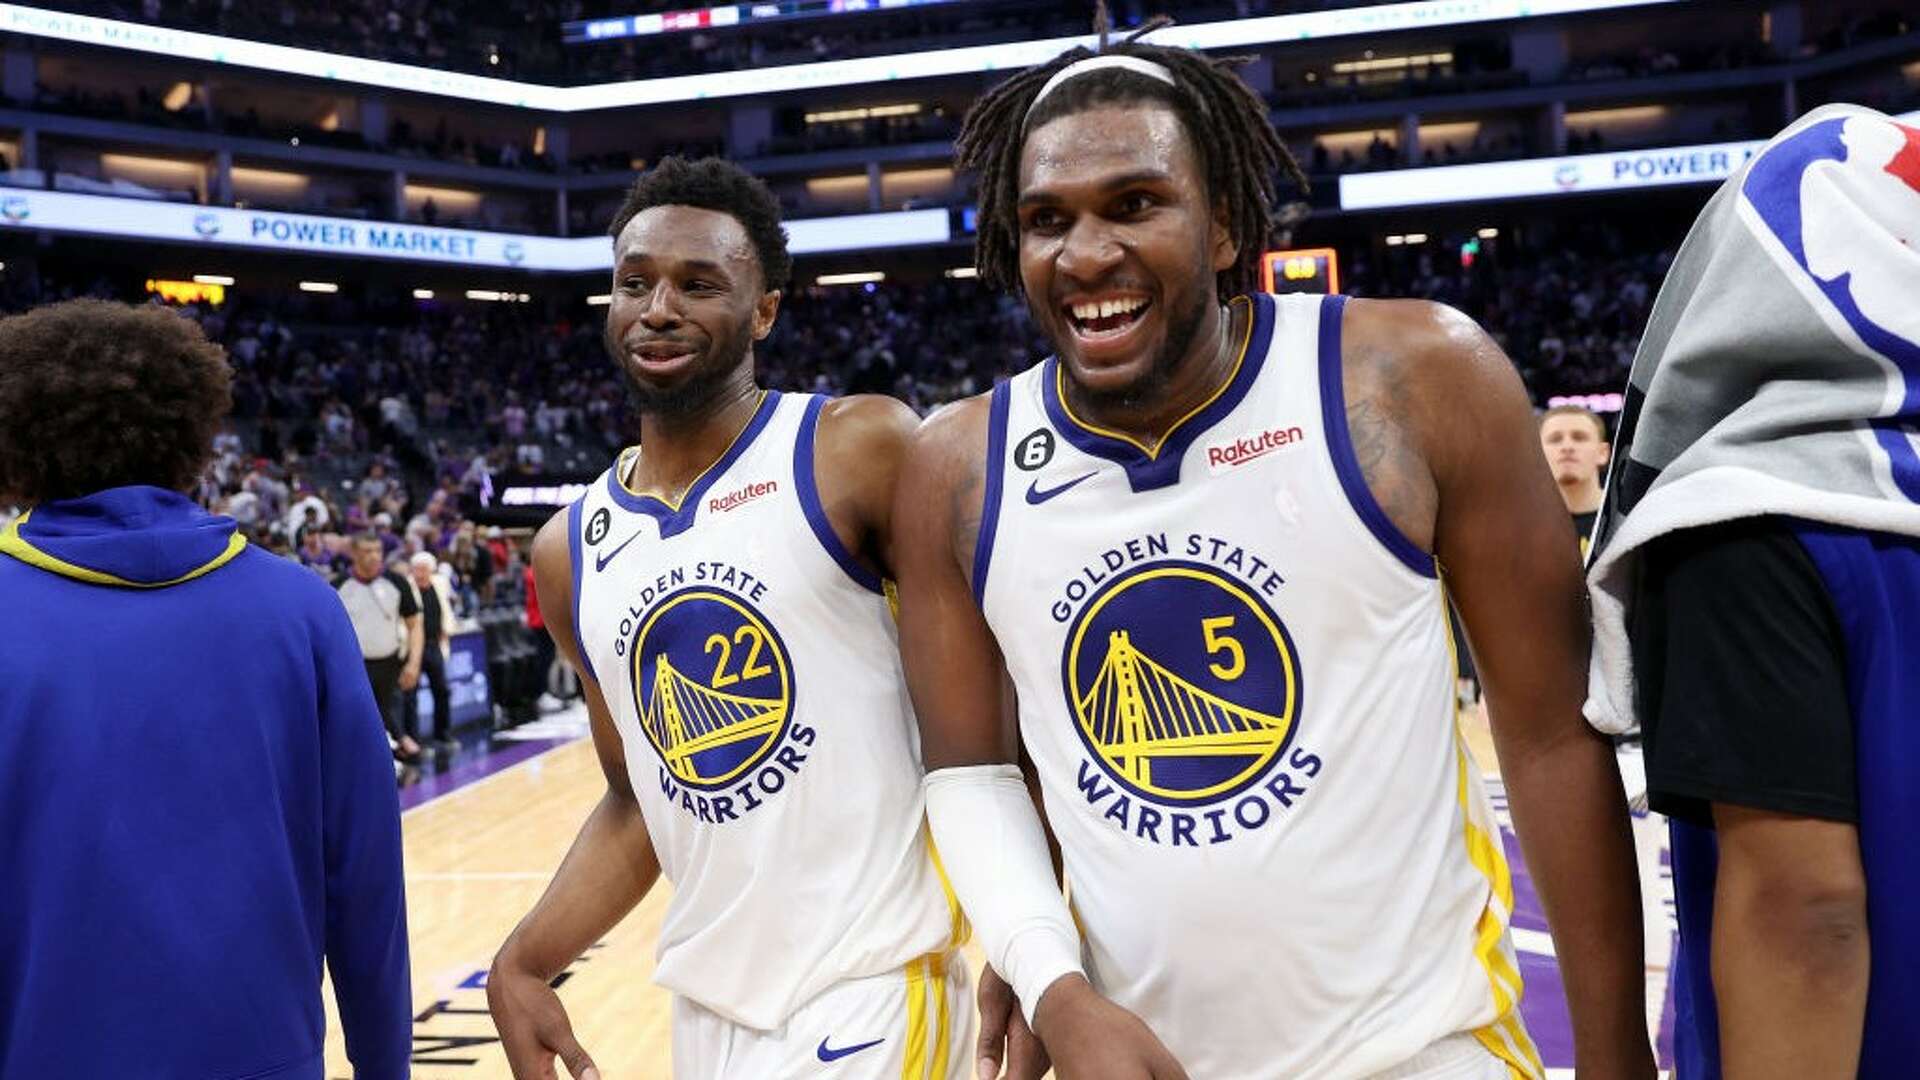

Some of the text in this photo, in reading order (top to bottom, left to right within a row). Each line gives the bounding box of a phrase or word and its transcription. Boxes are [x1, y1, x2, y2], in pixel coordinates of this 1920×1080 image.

[1613, 152, 1728, 180] POWER
[252, 218, 477, 257] POWER MARKET
[1021, 433, 1049, 468] 6
[1208, 426, 1303, 467] Rakuten
[709, 480, 777, 513] Rakuten
[589, 511, 608, 543] 6
[1051, 532, 1285, 623] GOLDEN STATE
[614, 562, 768, 657] GOLDEN STATE
[704, 625, 772, 689] 22
[1202, 615, 1246, 681] 5
[658, 722, 816, 824] WARRIORS
[1077, 746, 1322, 847] WARRIORS
